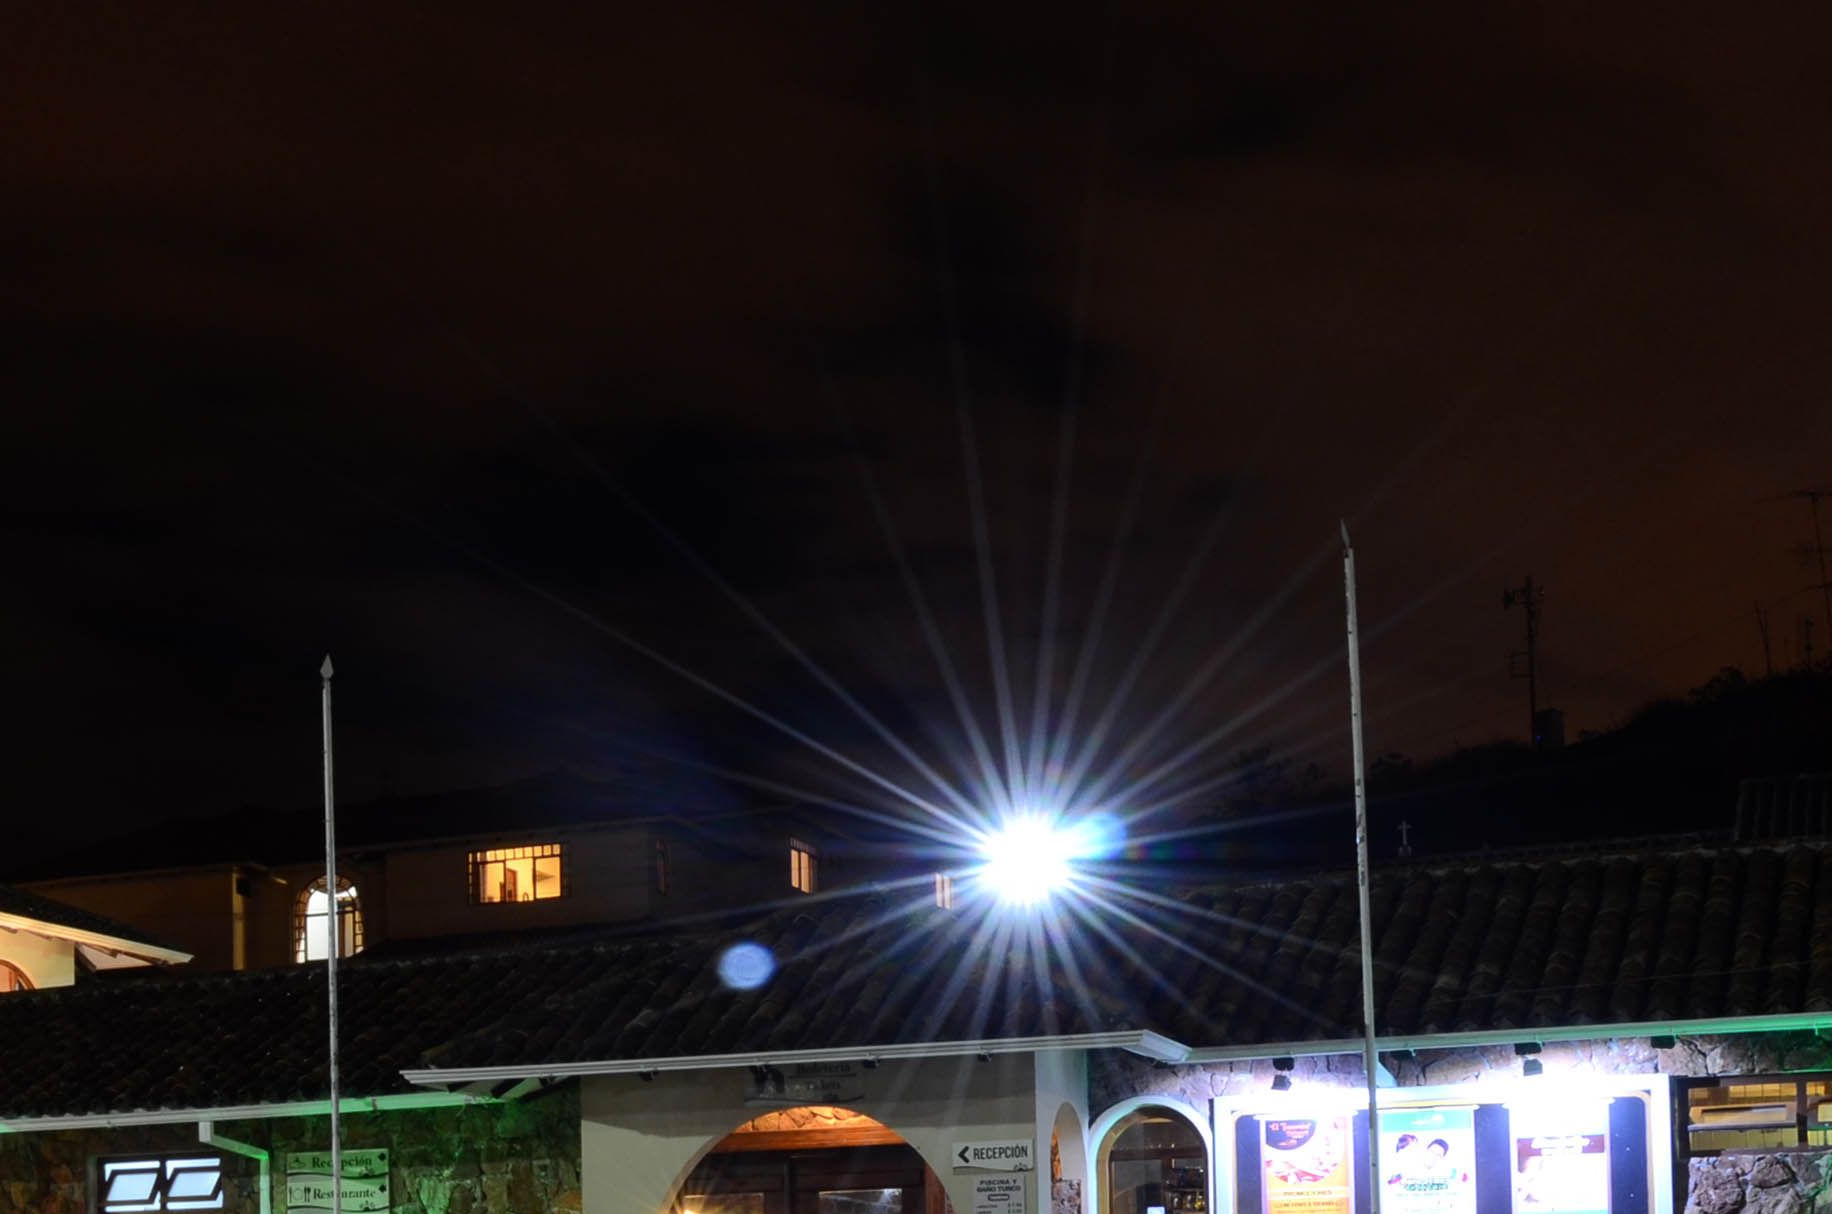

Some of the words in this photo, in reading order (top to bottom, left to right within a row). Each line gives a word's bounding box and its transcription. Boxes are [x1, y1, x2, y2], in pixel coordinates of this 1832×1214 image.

[972, 1145, 1028, 1160] RECEPCIÓN
[312, 1156, 373, 1171] Recpción
[313, 1187, 376, 1200] Resturante
